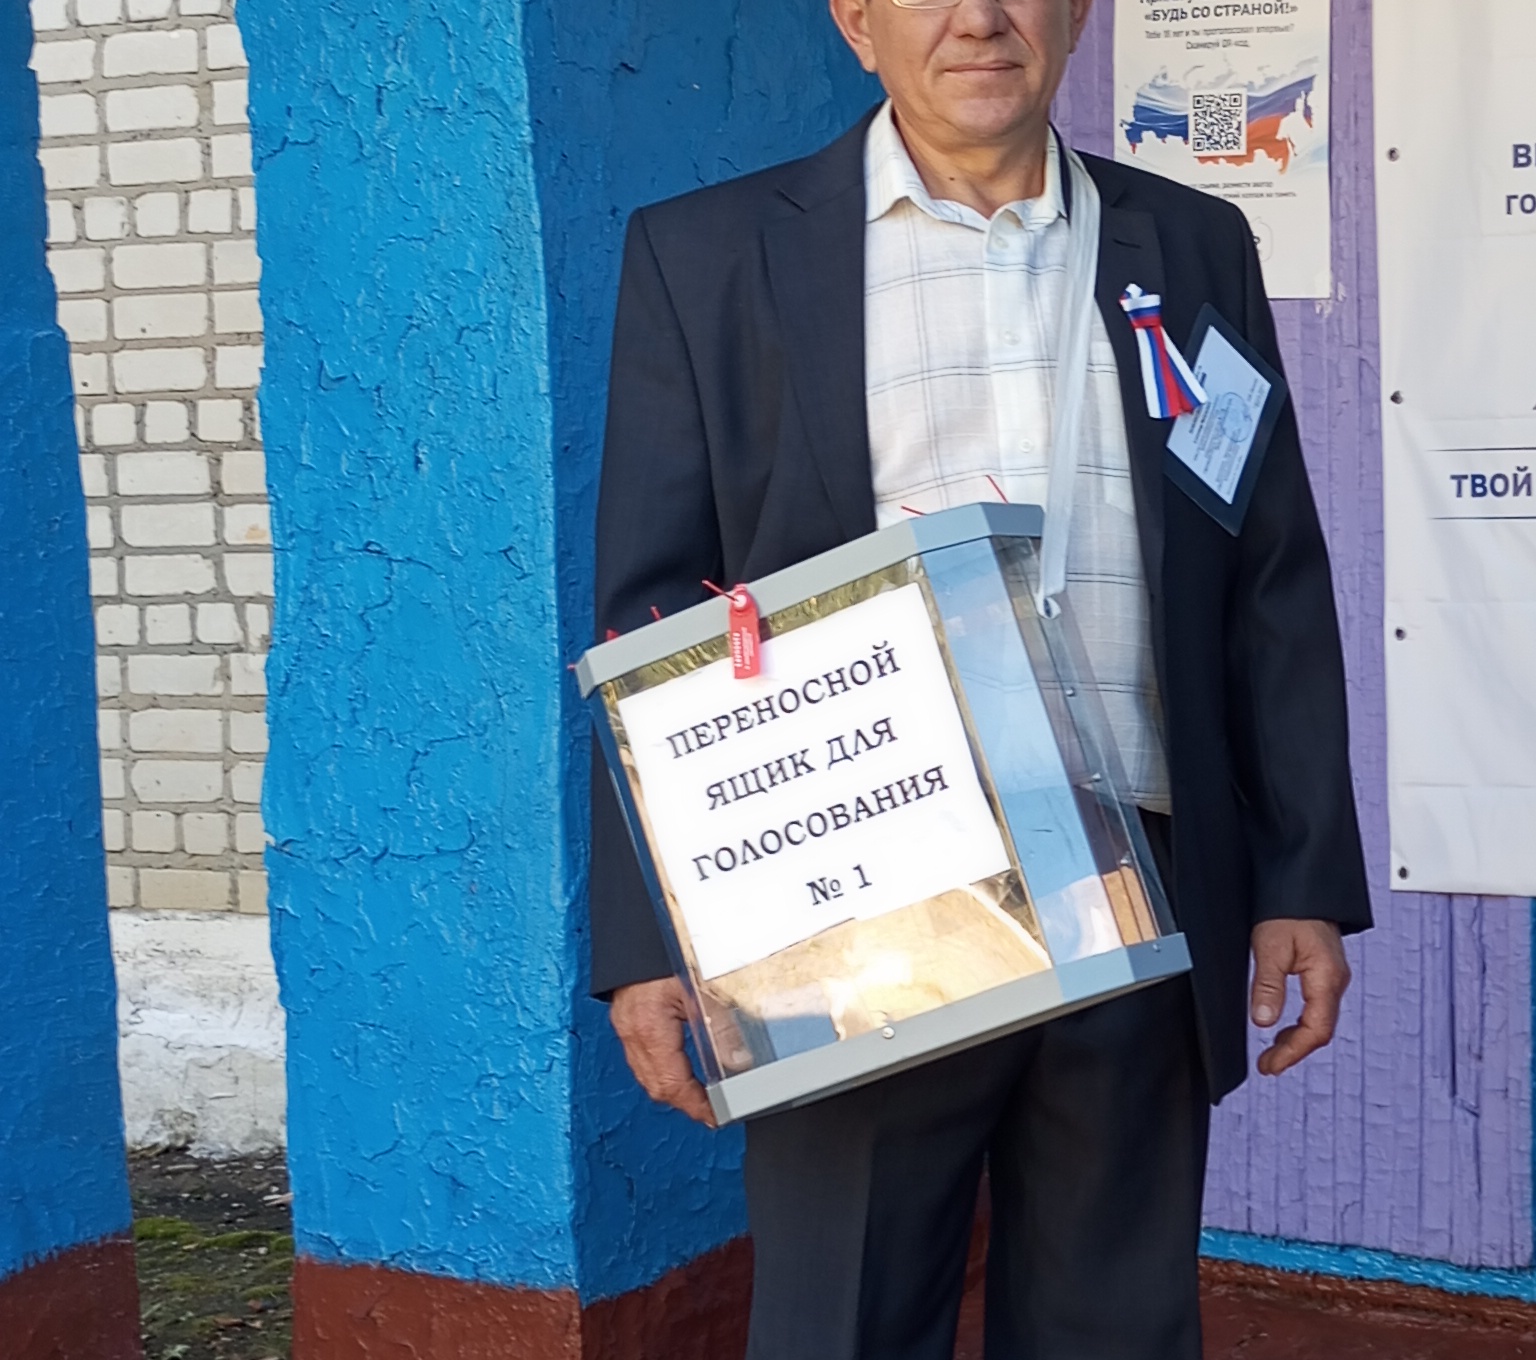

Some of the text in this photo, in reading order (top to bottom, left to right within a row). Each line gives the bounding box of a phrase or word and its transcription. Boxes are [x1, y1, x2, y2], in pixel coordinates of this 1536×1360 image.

[1191, 5, 1210, 19] СО
[1450, 465, 1532, 498] ТВОЙ
[665, 640, 901, 759] ПЕРЕНОСНОЙ
[705, 717, 898, 811] ЯЩИК ДЛЯ
[692, 764, 949, 881] ГОЛОСОВАНИЯ
[806, 864, 873, 906] № 1
